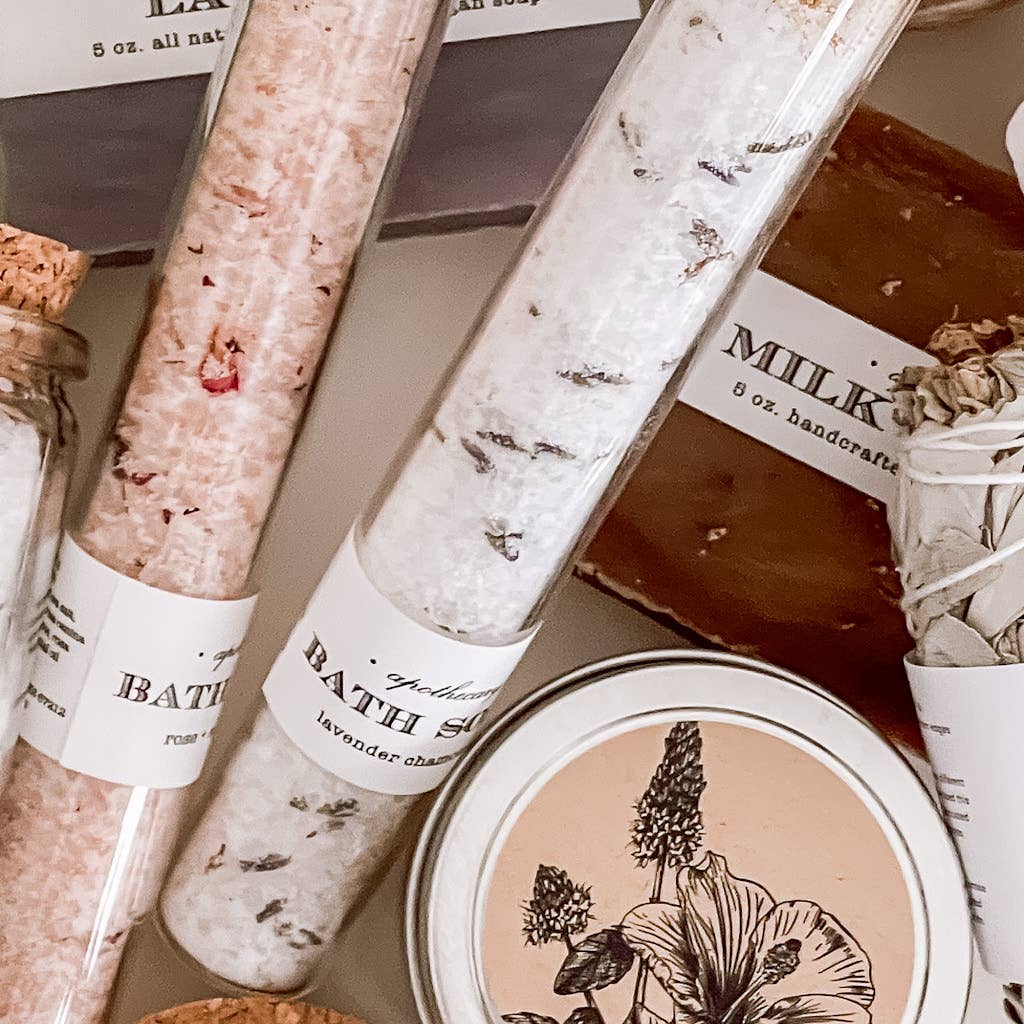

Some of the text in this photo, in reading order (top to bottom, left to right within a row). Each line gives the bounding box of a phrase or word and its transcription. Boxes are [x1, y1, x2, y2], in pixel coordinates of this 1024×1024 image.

[93, 42, 105, 58] 5
[113, 41, 144, 55] oz.
[152, 32, 180, 50] all
[721, 323, 895, 431] MILK
[733, 381, 747, 397] 5
[751, 394, 778, 416] oz.
[303, 631, 426, 736] BATH
[316, 710, 400, 763] lavender
